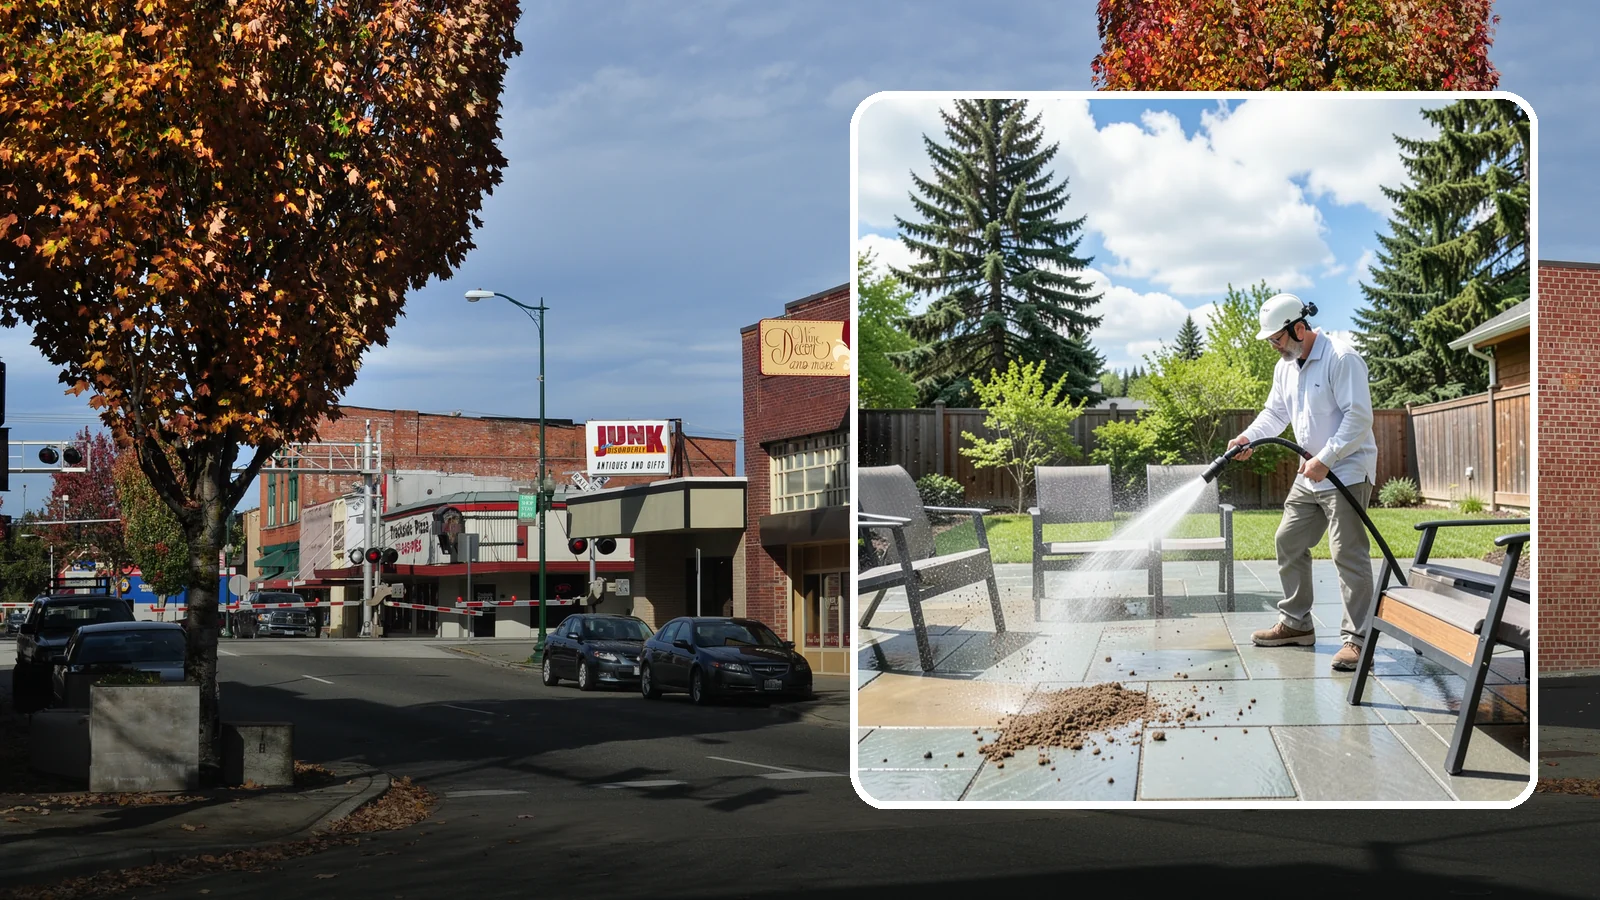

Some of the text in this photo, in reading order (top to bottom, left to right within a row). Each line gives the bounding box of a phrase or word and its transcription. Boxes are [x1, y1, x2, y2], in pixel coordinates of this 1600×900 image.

[595, 425, 665, 457] JUNK
[607, 446, 645, 454] DISORDERLY
[597, 460, 665, 470] ANTIQUES AND GIFTS
[414, 519, 429, 534] Pizza
